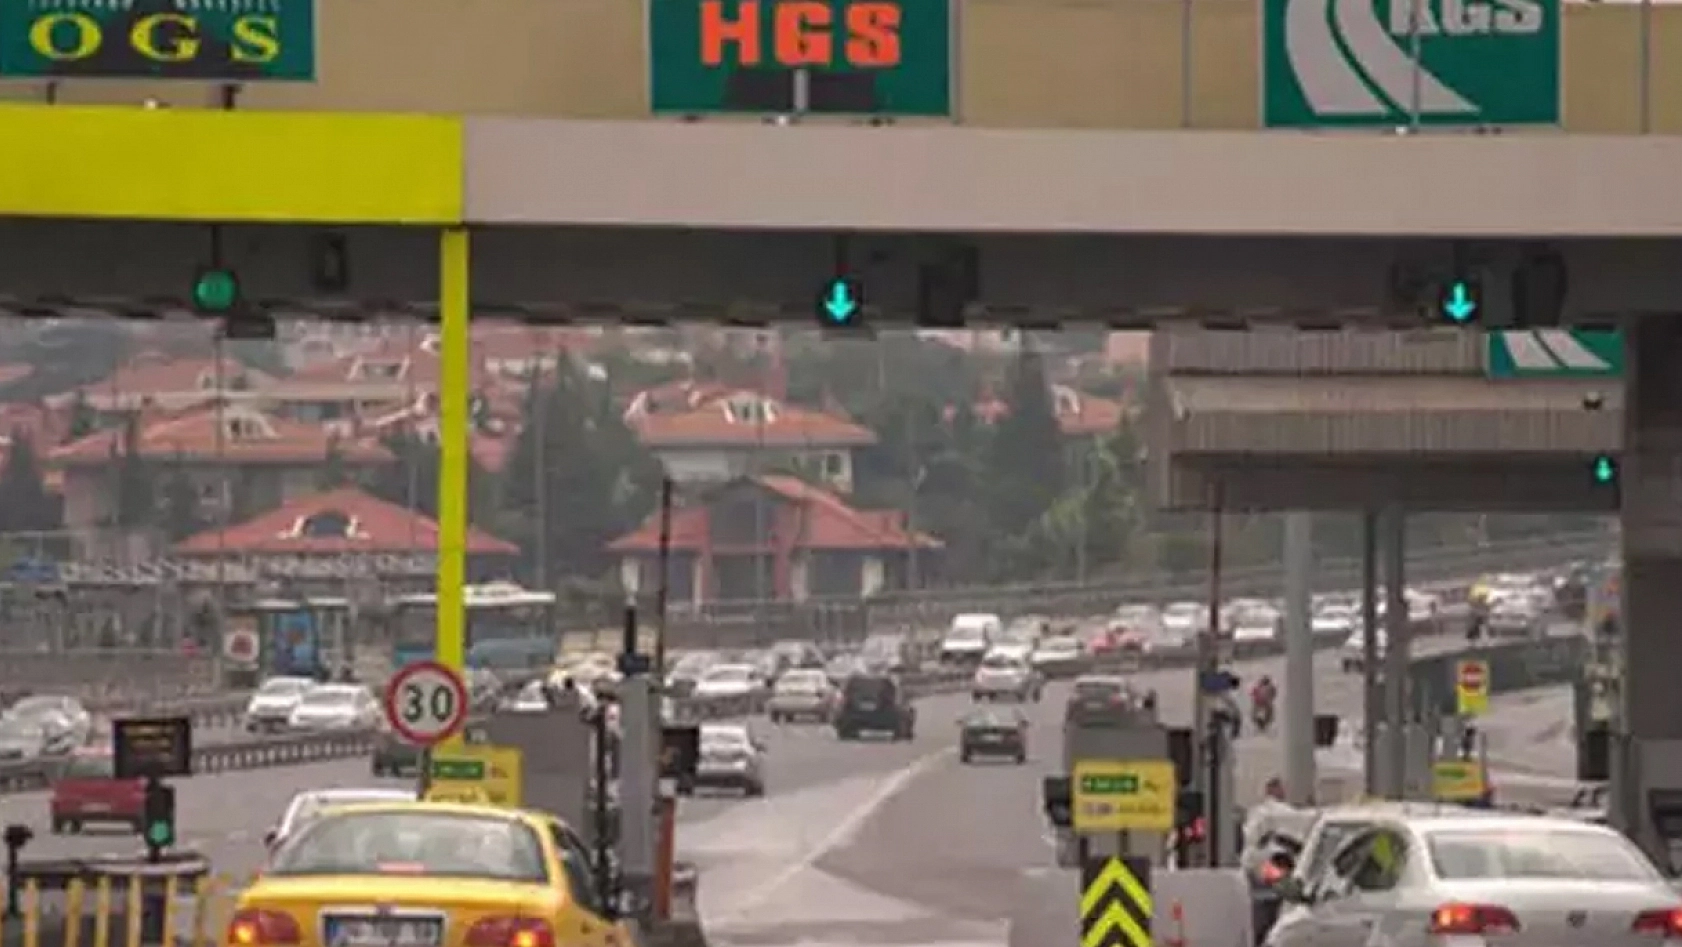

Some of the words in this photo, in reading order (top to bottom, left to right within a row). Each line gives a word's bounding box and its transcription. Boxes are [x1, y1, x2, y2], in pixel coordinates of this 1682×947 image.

[29, 12, 280, 63] OGS
[701, 0, 902, 66] HGS
[403, 684, 453, 723] 30
